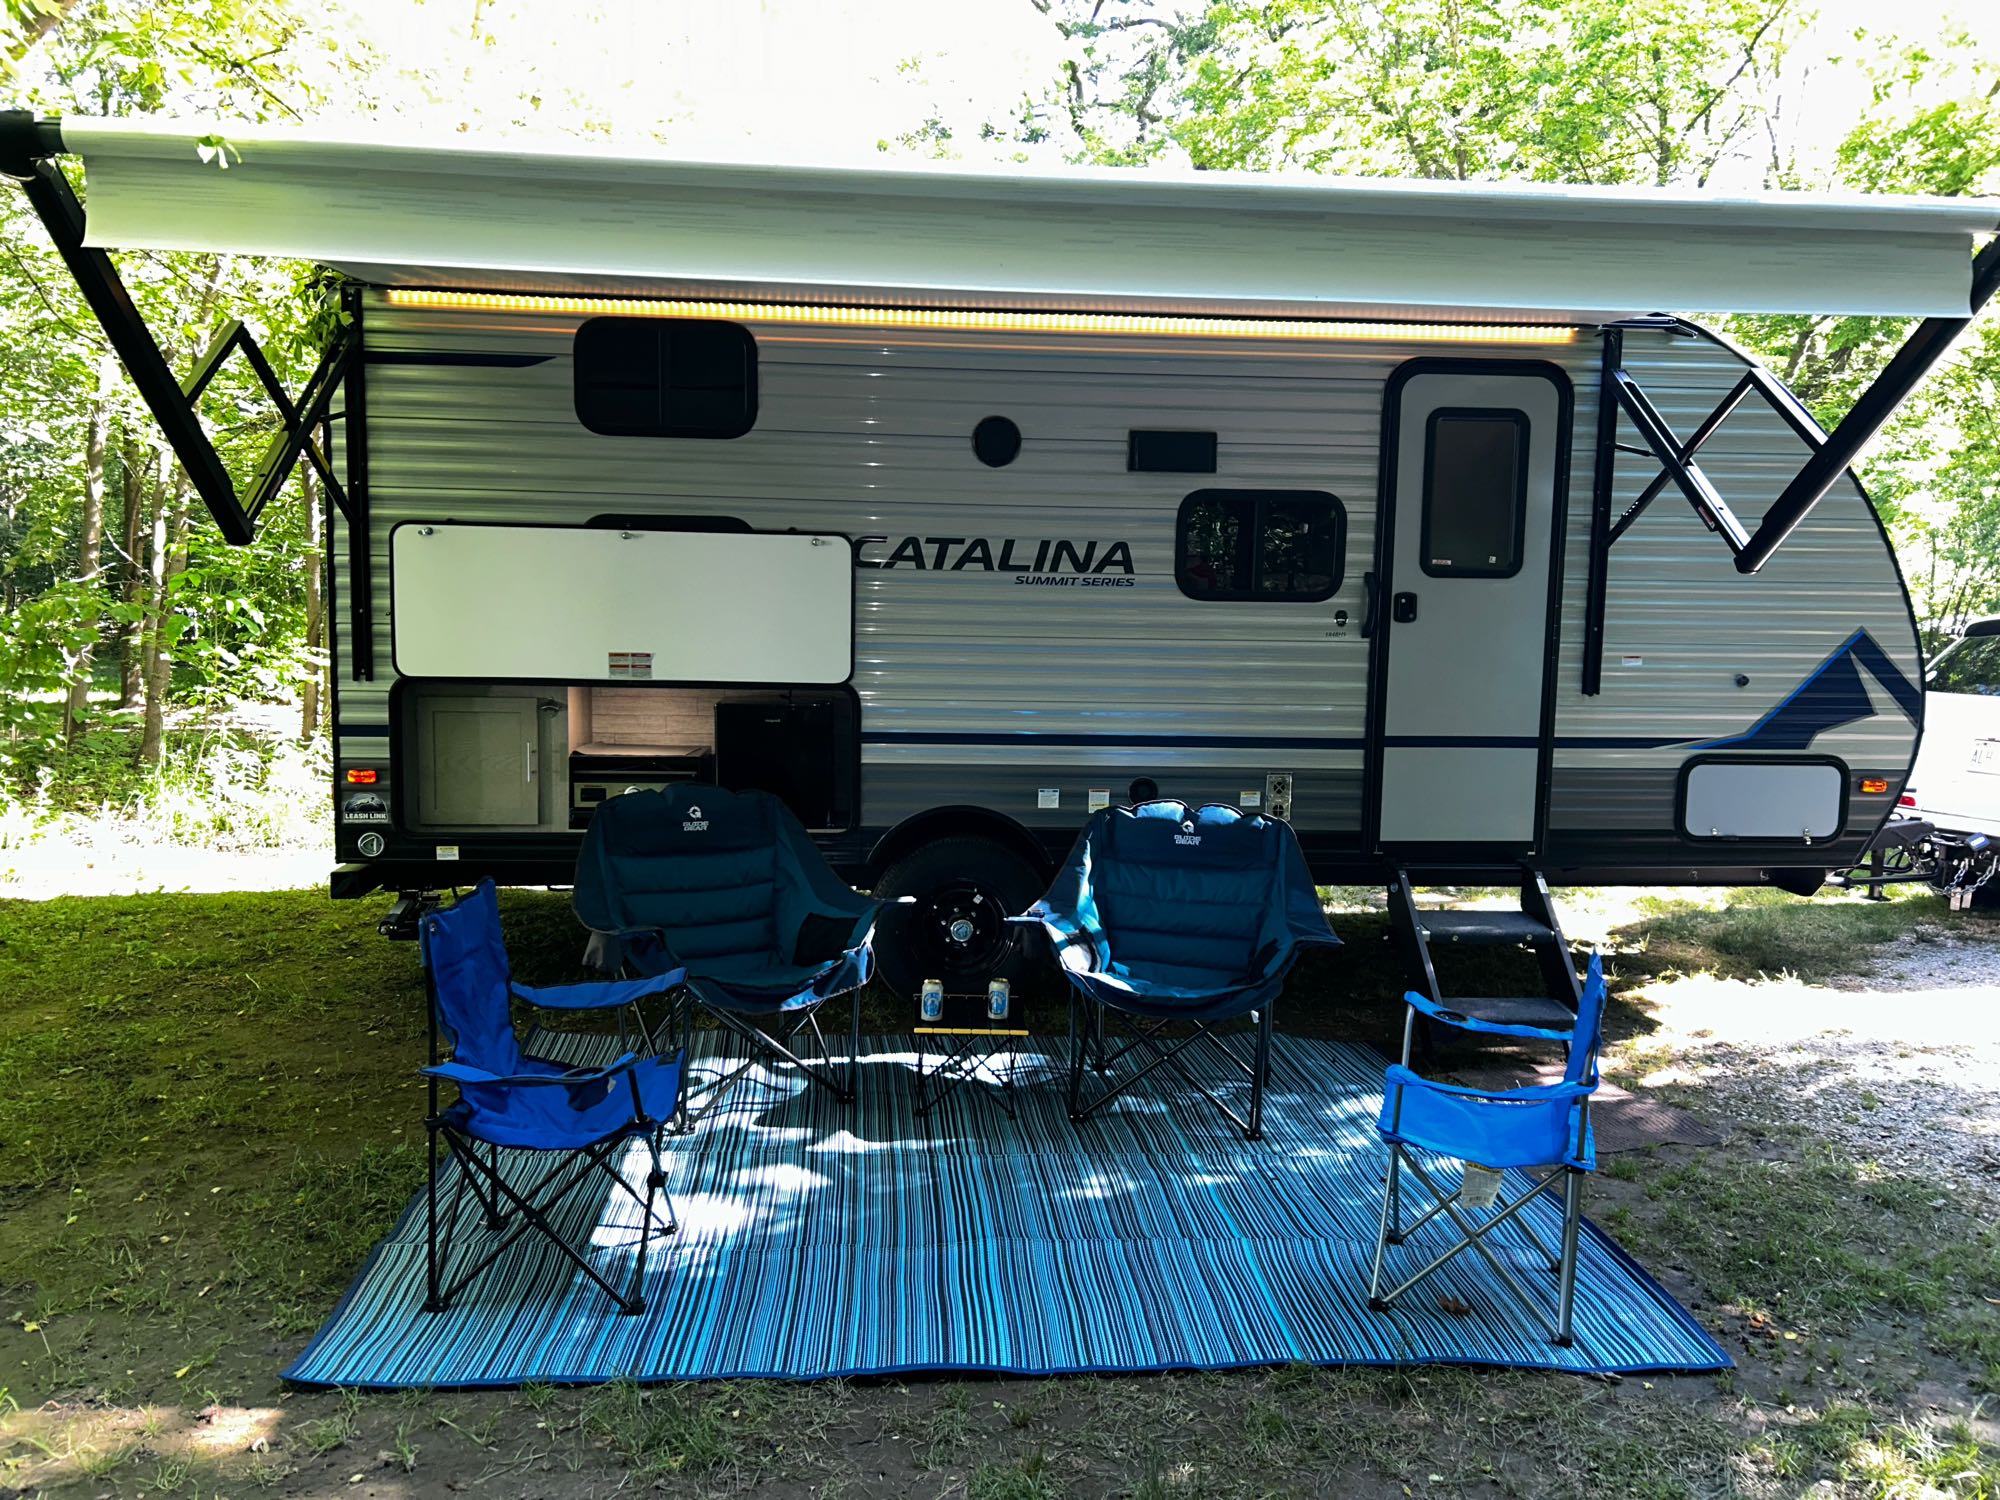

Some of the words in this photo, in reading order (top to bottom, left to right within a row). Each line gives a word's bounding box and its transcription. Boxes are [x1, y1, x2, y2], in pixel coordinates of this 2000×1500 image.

[854, 536, 1135, 575] CATALINA
[1014, 575, 1080, 586] SUMMIT
[1080, 577, 1136, 588] SERIES
